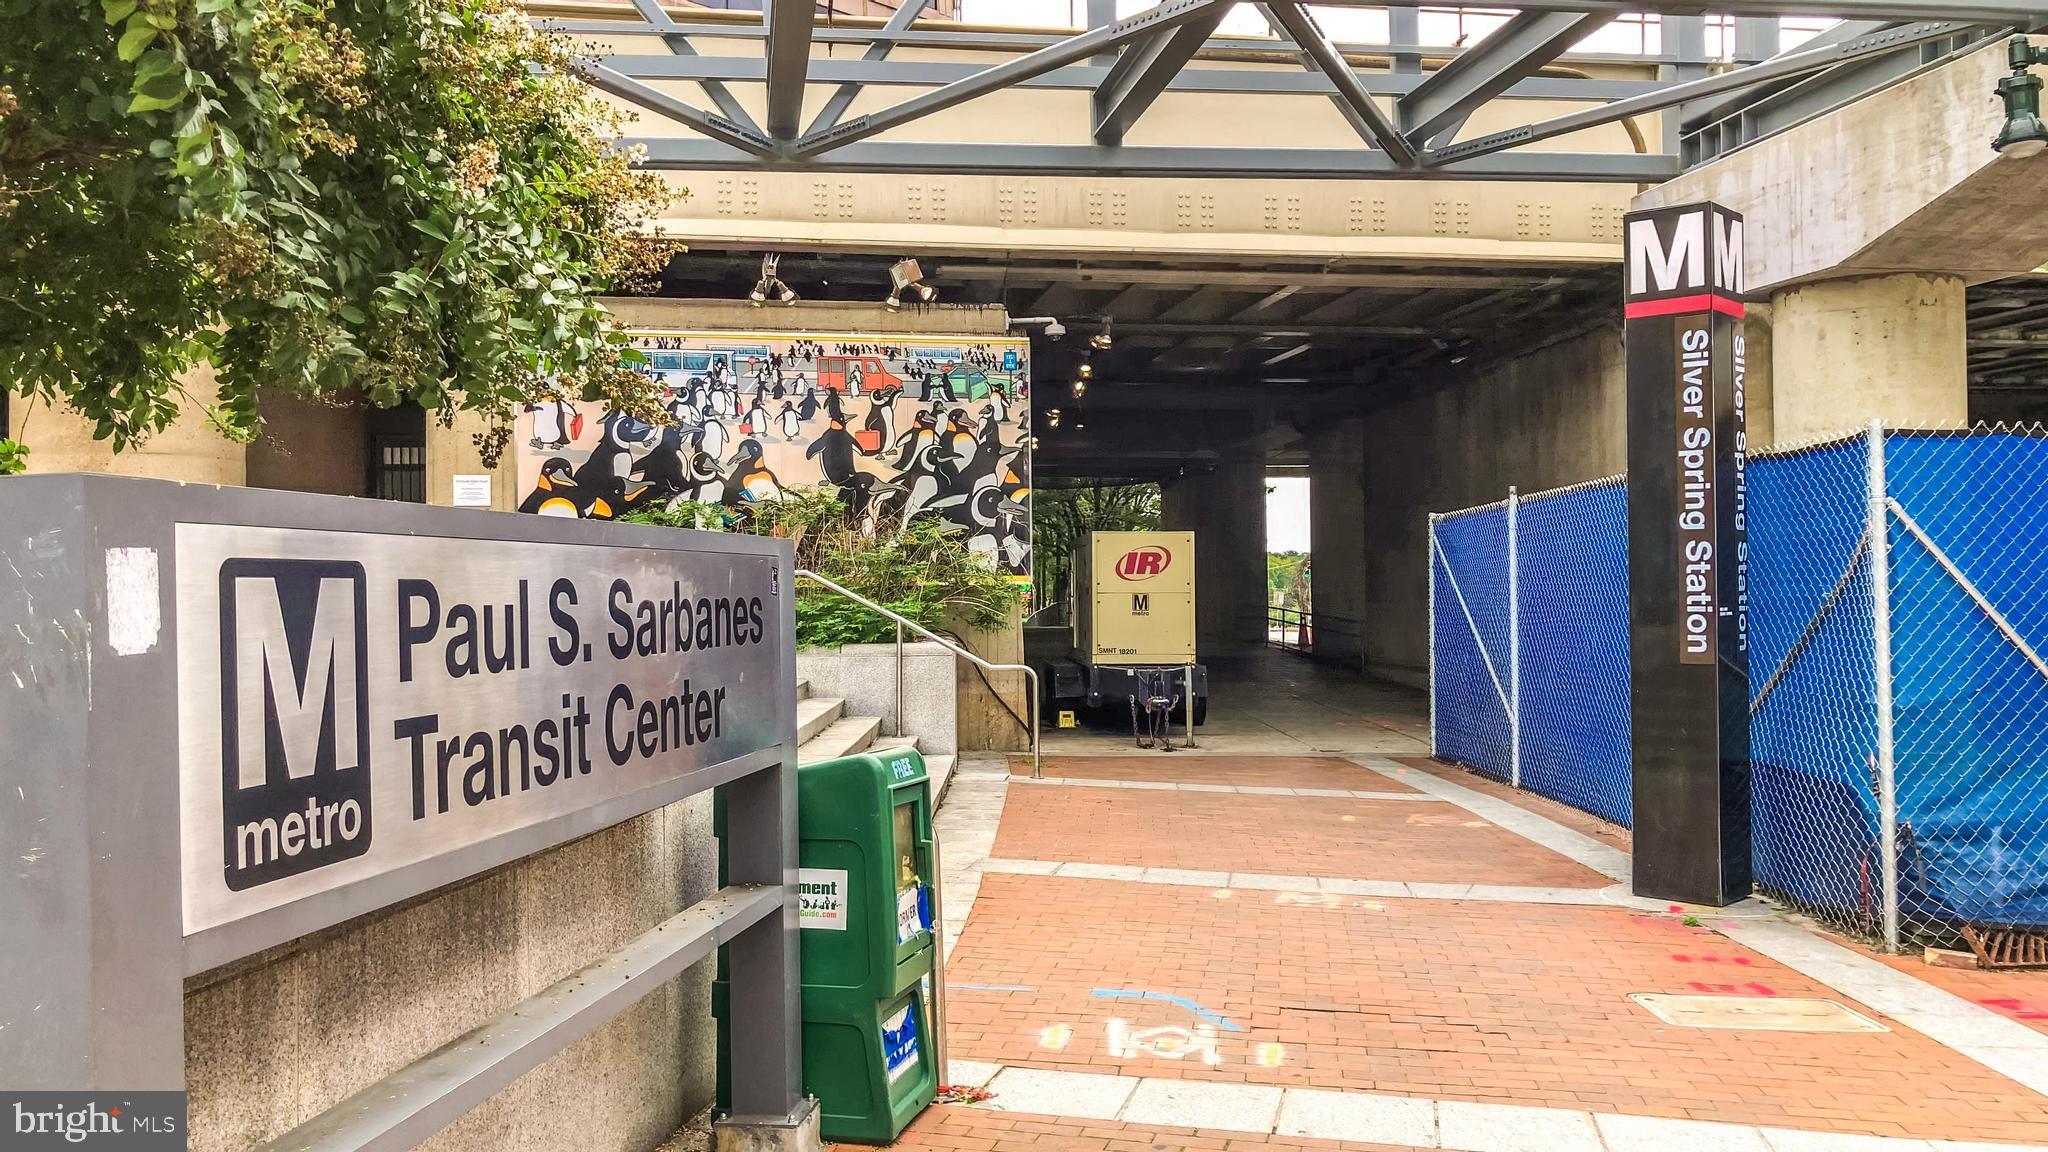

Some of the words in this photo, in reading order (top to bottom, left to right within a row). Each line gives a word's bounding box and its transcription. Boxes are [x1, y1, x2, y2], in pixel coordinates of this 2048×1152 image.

[1629, 210, 1705, 295] M
[1713, 211, 1744, 295] M
[1682, 329, 1709, 418] Silver
[1734, 335, 1745, 422] Silver
[1678, 427, 1711, 530] Spring
[1734, 431, 1747, 531] Spring
[1124, 552, 1162, 575] IR
[1134, 594, 1148, 610] M
[1685, 540, 1713, 653] Station
[1738, 541, 1748, 651] Station
[397, 578, 530, 683] Paul
[548, 577, 592, 667] S.
[607, 578, 764, 660] Sarbanes
[235, 576, 358, 790] M
[394, 693, 592, 821] Transit
[605, 679, 726, 766] Center
[891, 757, 915, 780] FREE
[237, 796, 362, 870] metro
